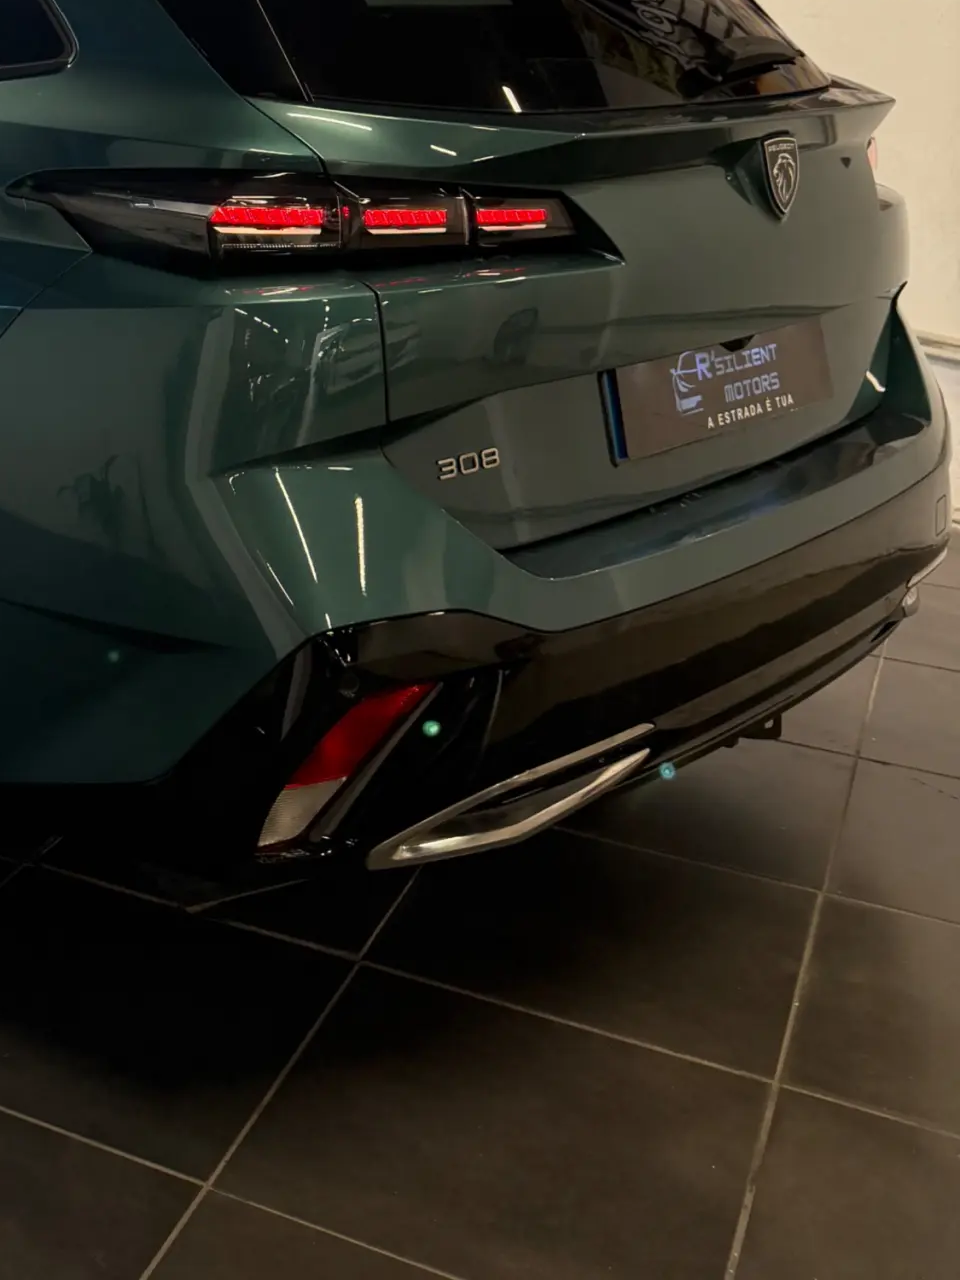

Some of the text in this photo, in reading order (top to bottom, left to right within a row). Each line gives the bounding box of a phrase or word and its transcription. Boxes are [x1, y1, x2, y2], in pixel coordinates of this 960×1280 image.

[695, 344, 777, 380] R'SILIENT
[724, 372, 780, 403] MOTORS
[707, 393, 794, 429] A ESTRADA É TUA
[436, 447, 500, 480] 308
